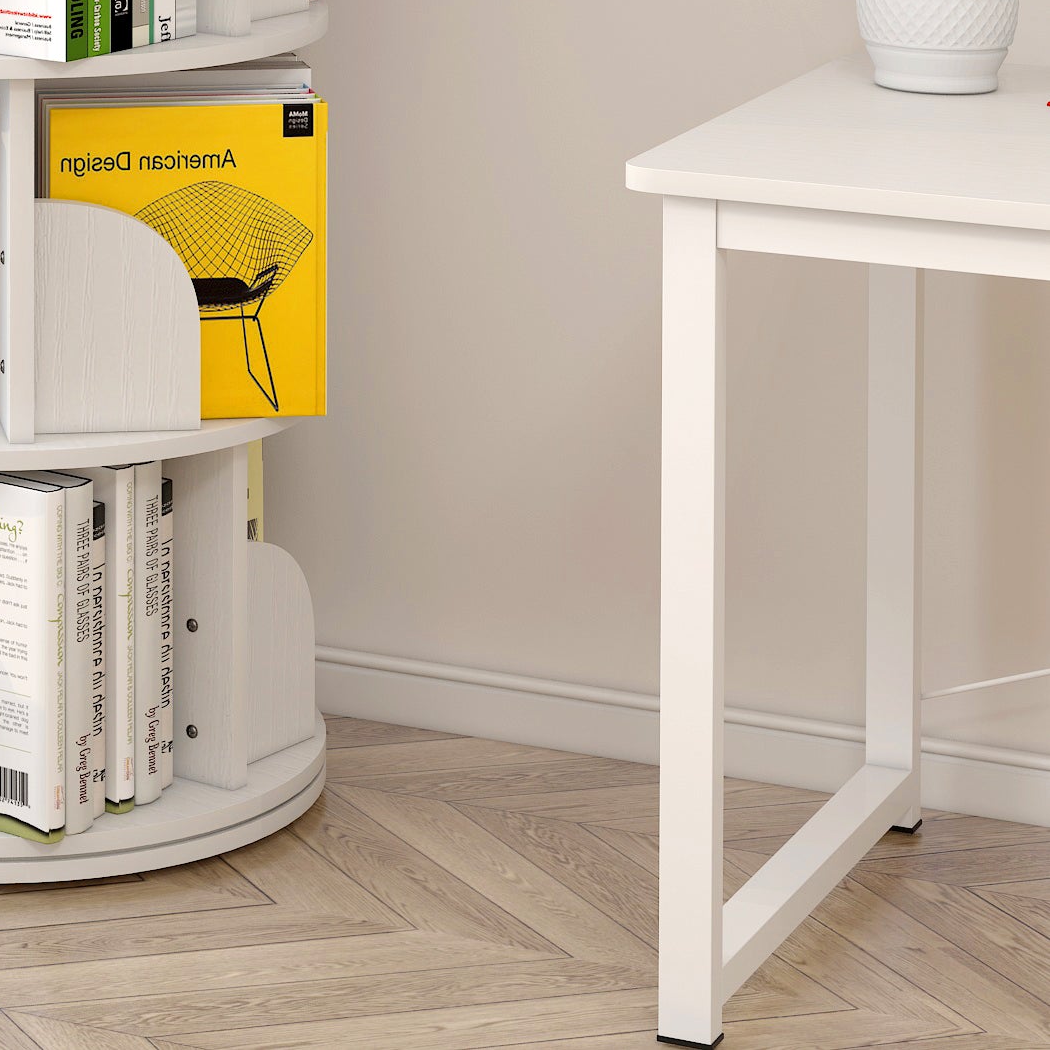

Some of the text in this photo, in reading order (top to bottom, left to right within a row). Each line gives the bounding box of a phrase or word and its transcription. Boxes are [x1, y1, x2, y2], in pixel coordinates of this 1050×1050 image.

[93, 28, 101, 51] Society
[77, 519, 89, 642] THREE PAIRS OF GLASSES
[146, 495, 158, 616] THREE PAIRS OF GLASSES
[48, 594, 63, 667] Compassion
[76, 734, 91, 804] by Greg Bennet
[145, 706, 159, 775] by Greg Bennet
